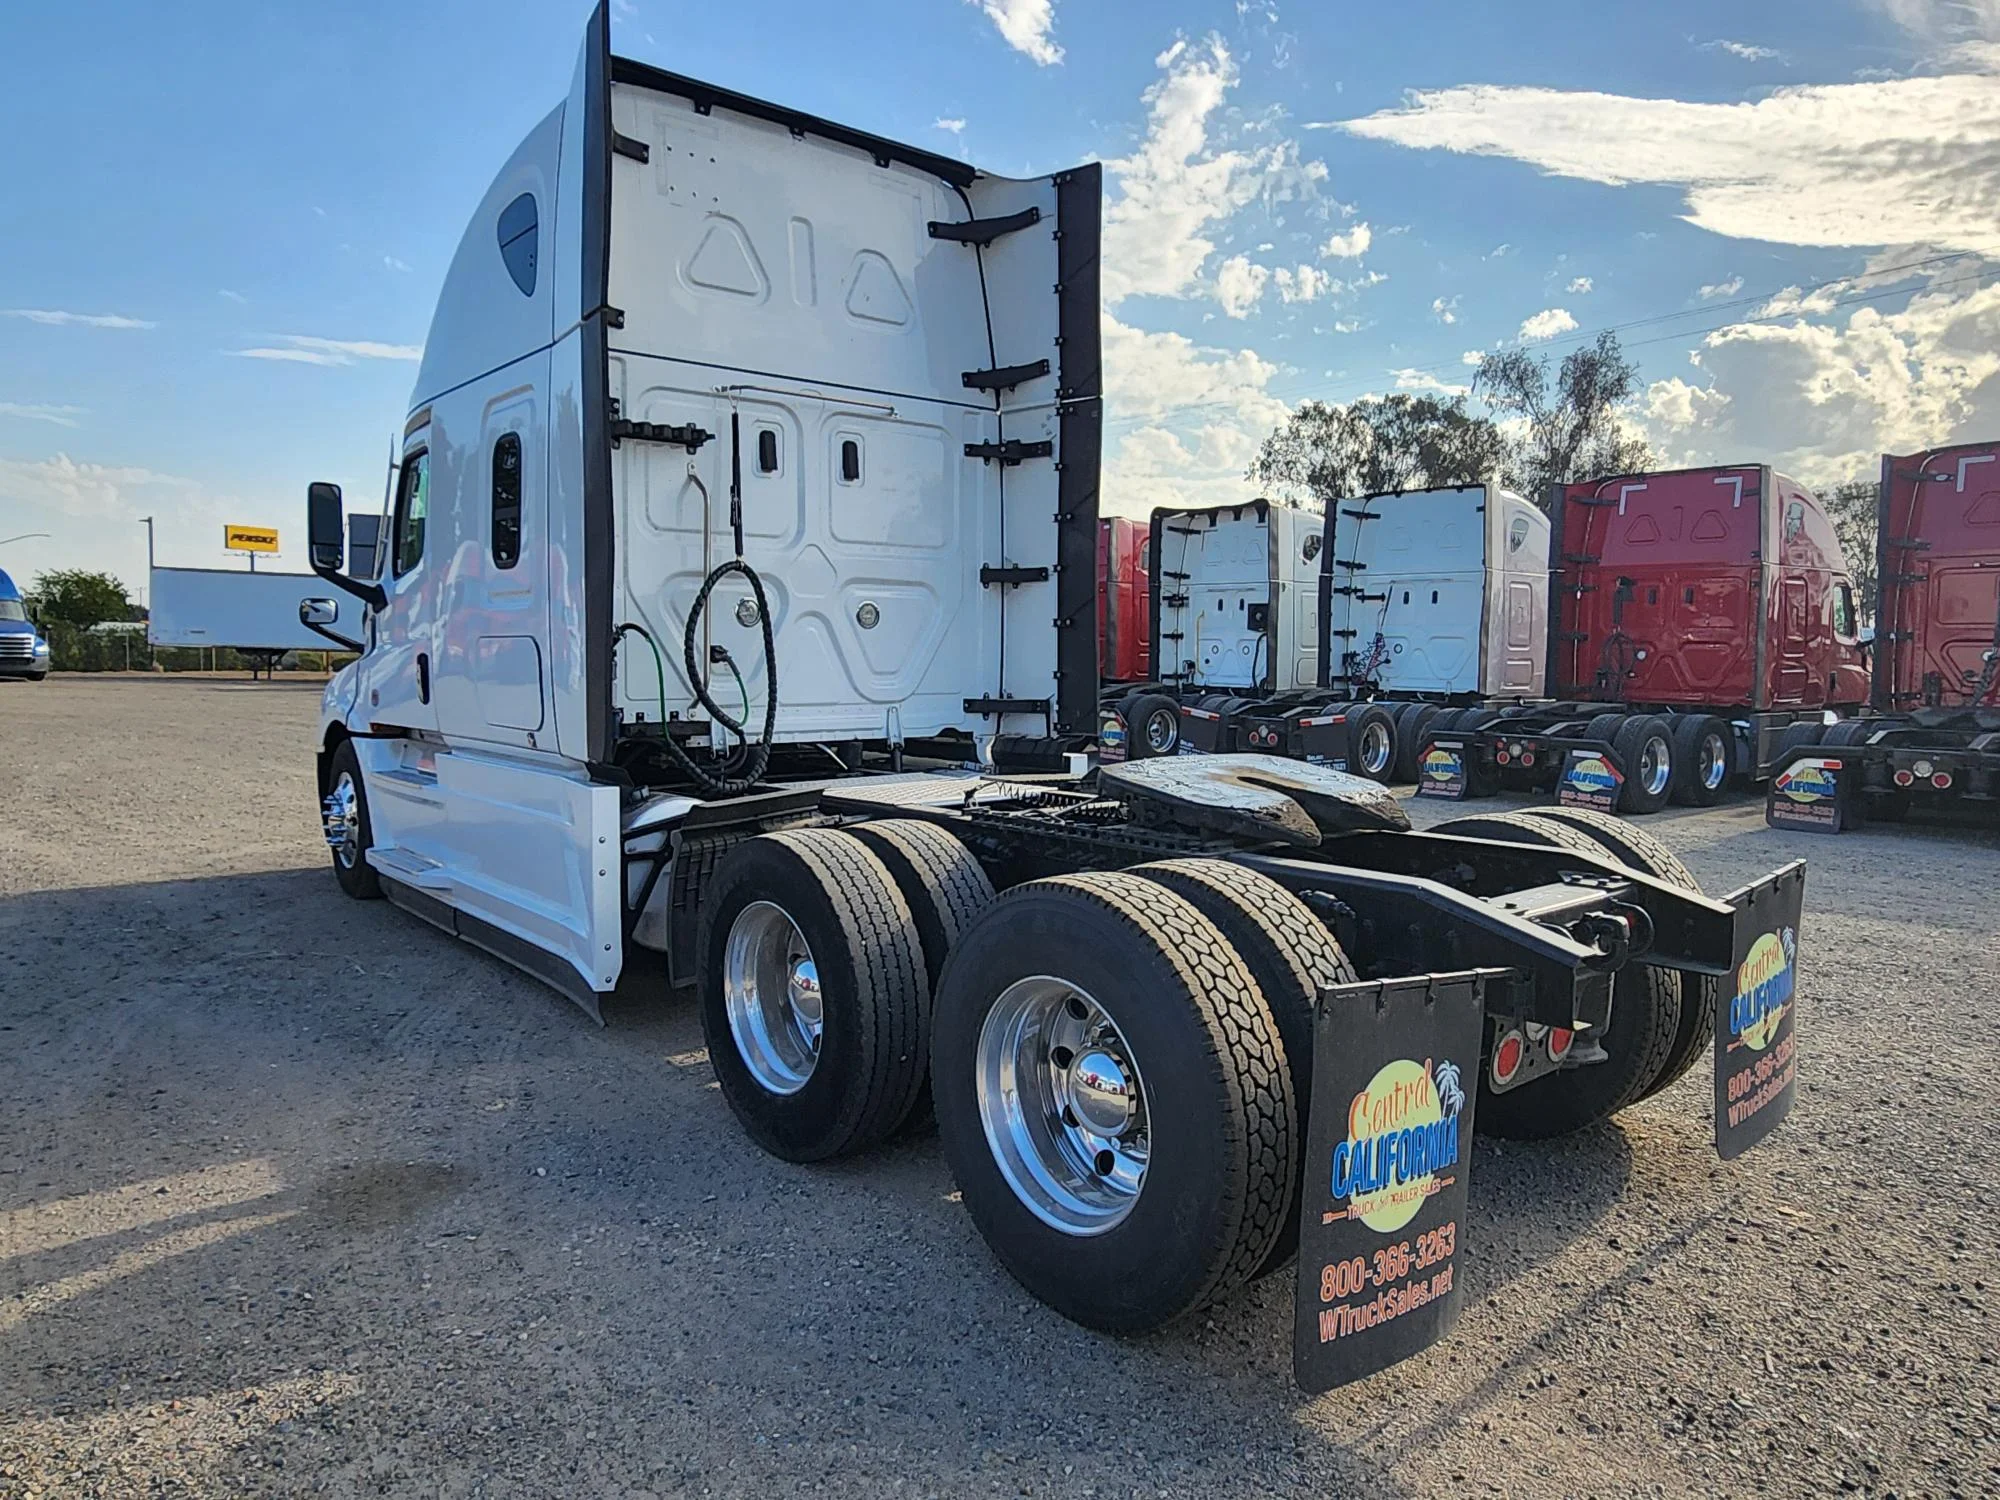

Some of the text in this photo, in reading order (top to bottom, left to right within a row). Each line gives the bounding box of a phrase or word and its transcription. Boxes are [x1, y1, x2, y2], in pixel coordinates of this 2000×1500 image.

[1348, 1058, 1432, 1142] Central
[1332, 1115, 1458, 1199] CALIFORNIA
[1347, 1200, 1375, 1220] TRUCK
[1390, 1187, 1419, 1206] TRAILER
[1420, 1178, 1441, 1196] SALES
[1320, 1221, 1456, 1302] 800-366-3263
[1319, 1262, 1454, 1343] WTruckSales.net
